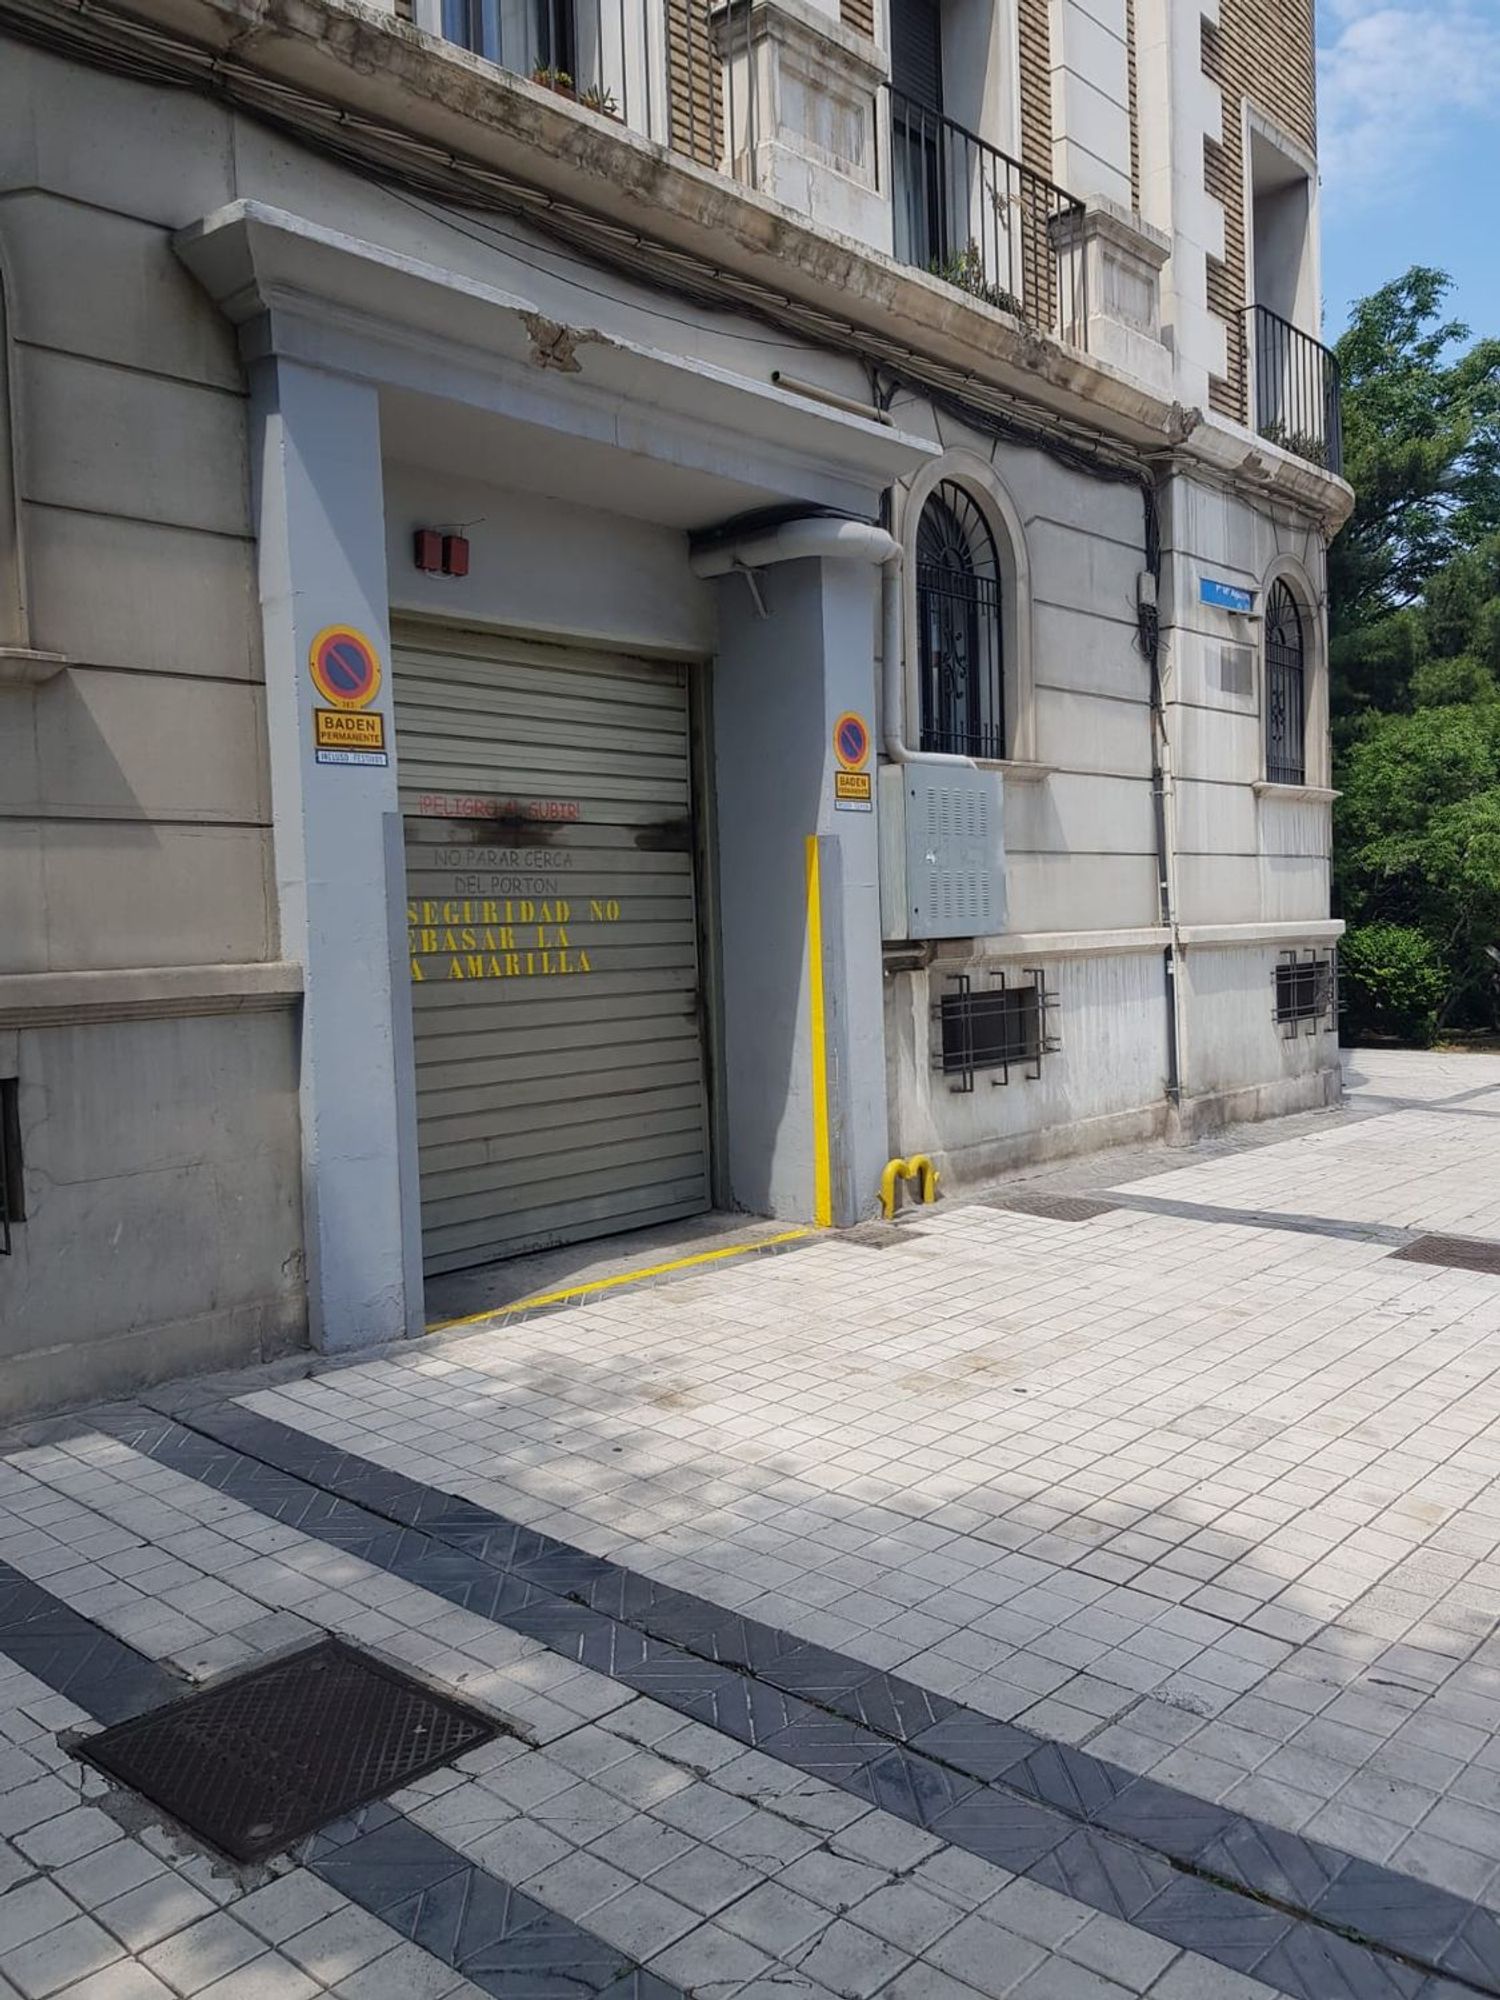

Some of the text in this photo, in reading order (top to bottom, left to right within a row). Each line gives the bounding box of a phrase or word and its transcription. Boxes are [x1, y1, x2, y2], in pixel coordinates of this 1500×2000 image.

[325, 717, 375, 732] BADEN
[321, 732, 380, 743] PERMANENTE
[528, 801, 580, 821] SUBIR!
[434, 850, 573, 868] NO PARAR CERCA
[454, 875, 558, 894] DEL PORTON
[406, 899, 620, 925] SEGURIDAD NO
[536, 925, 569, 948] LA
[448, 950, 592, 979] AMARILLA
